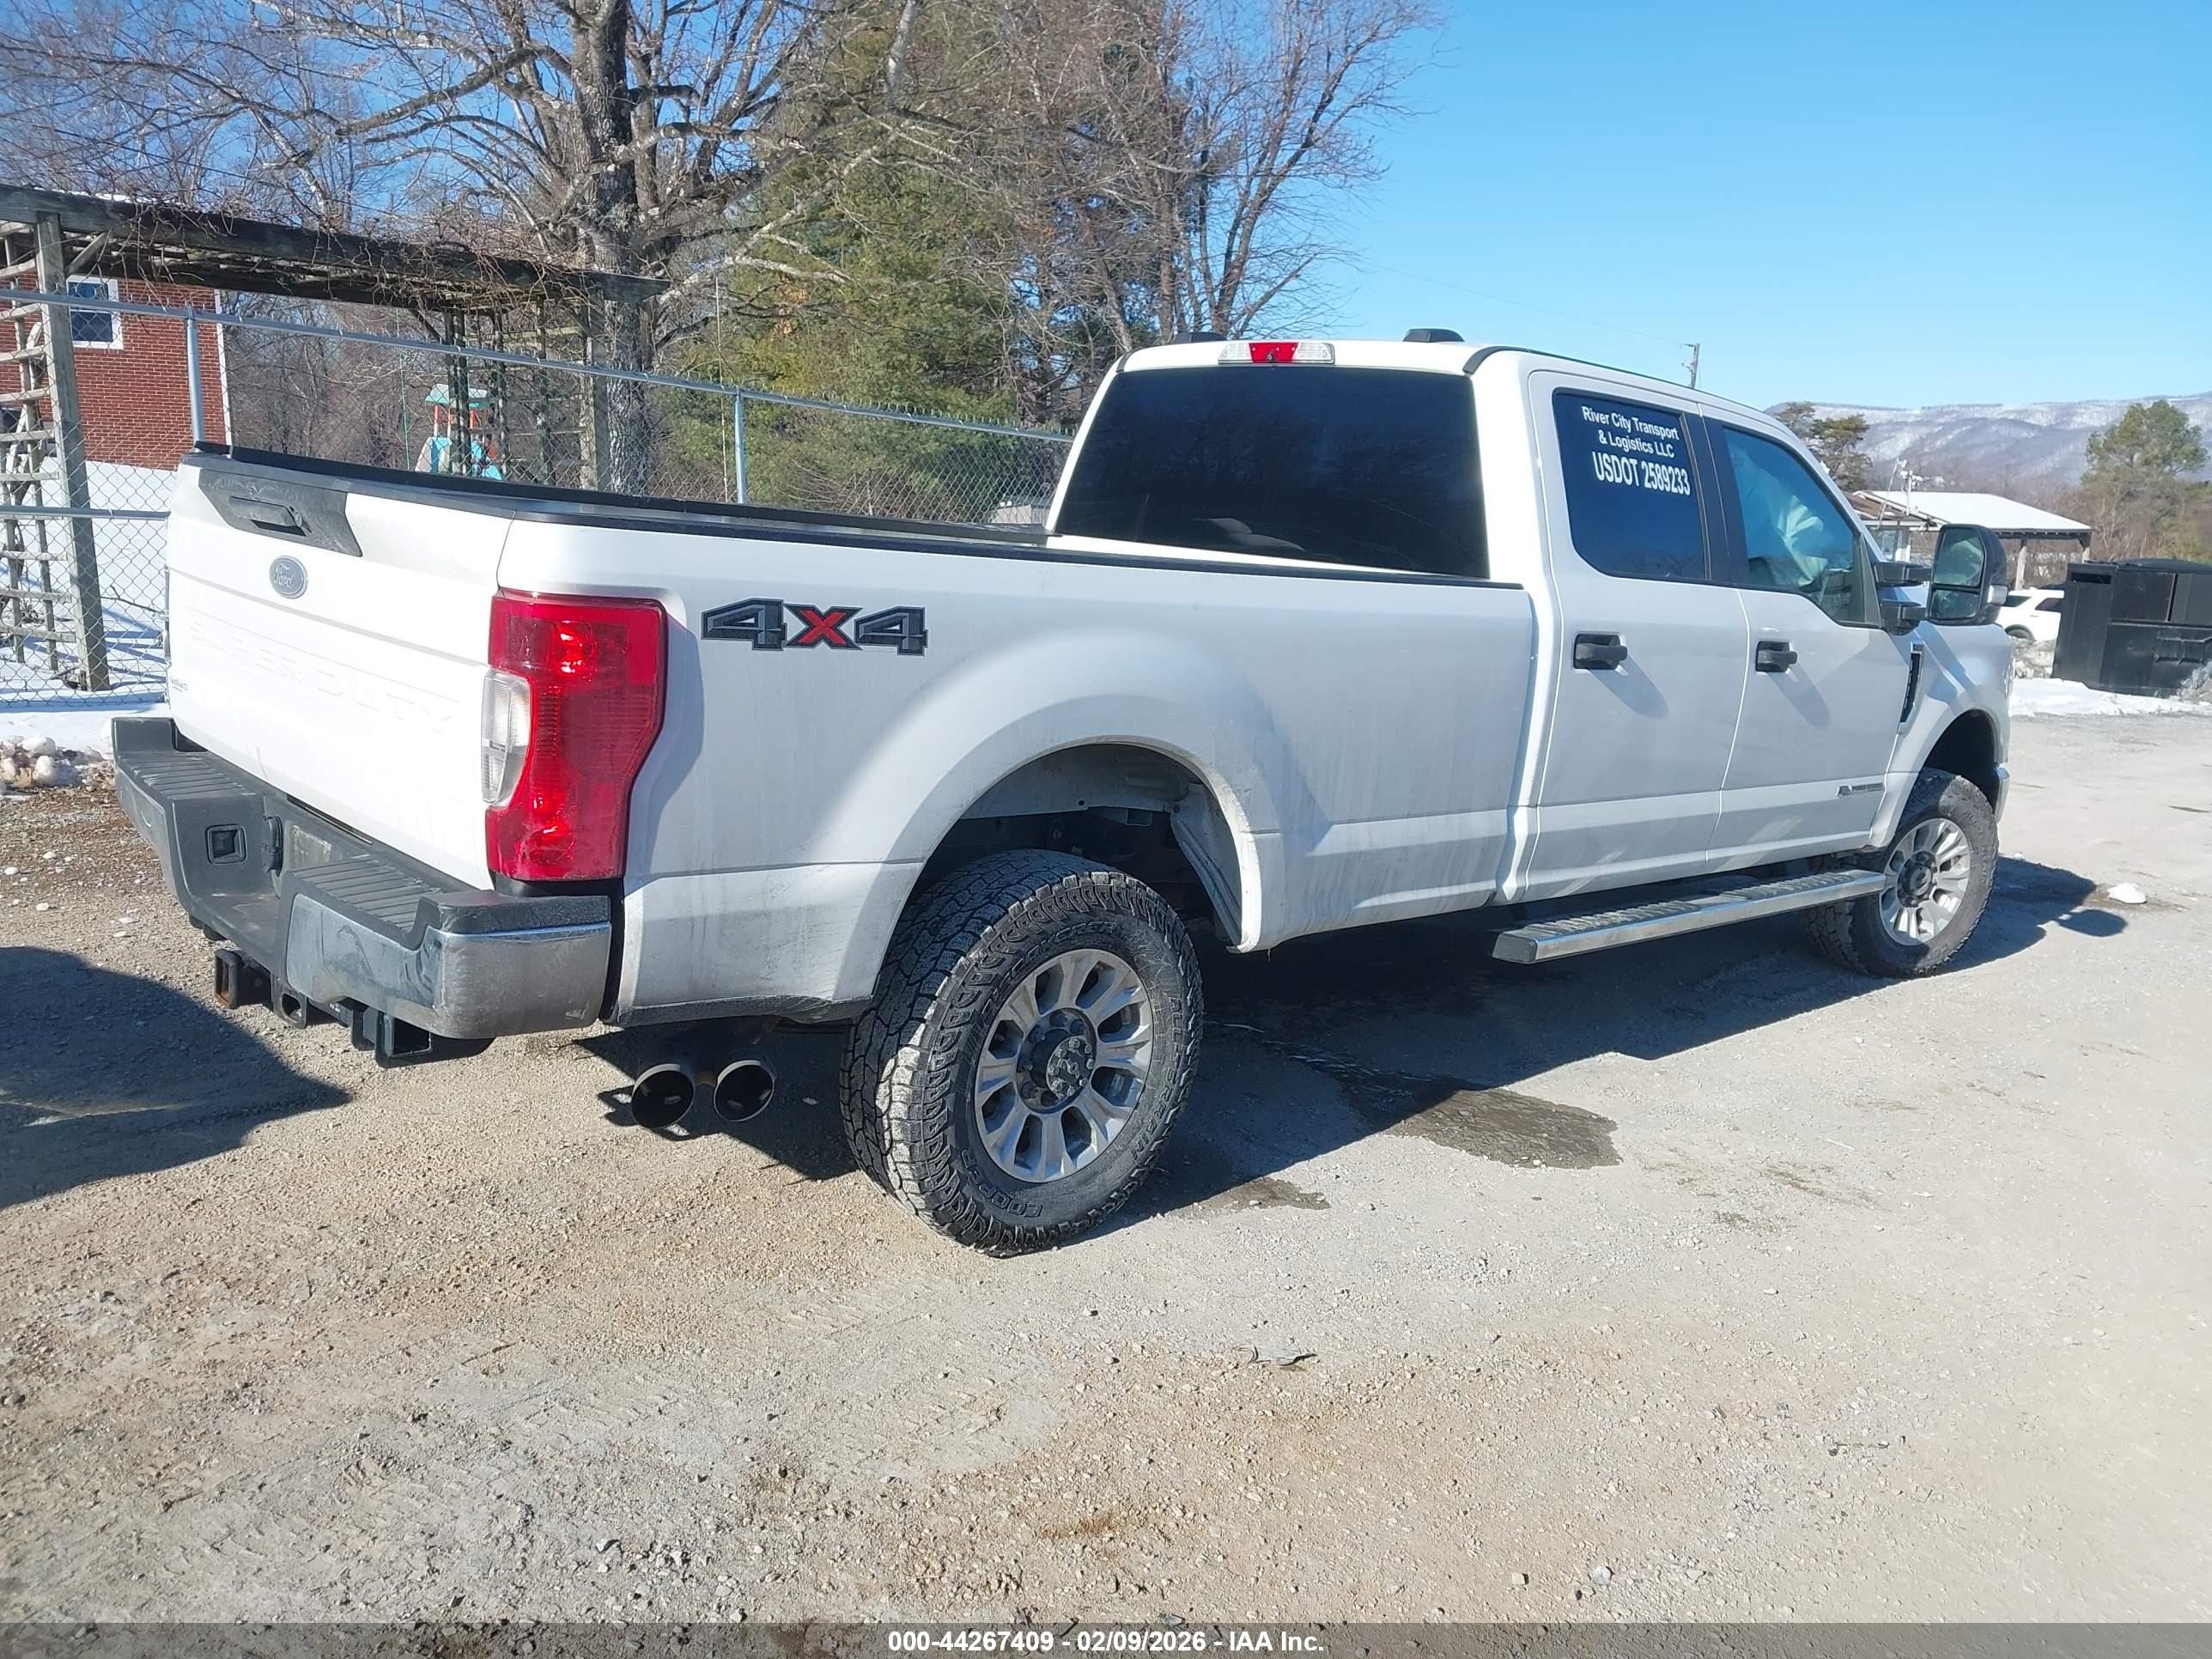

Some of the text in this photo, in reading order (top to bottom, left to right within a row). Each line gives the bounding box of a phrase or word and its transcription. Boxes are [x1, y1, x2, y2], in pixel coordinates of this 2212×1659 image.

[1582, 406, 1680, 441] River City Transport
[1598, 429, 1674, 459] & Logistics LLC
[1592, 452, 1691, 495] USDOT 2589233
